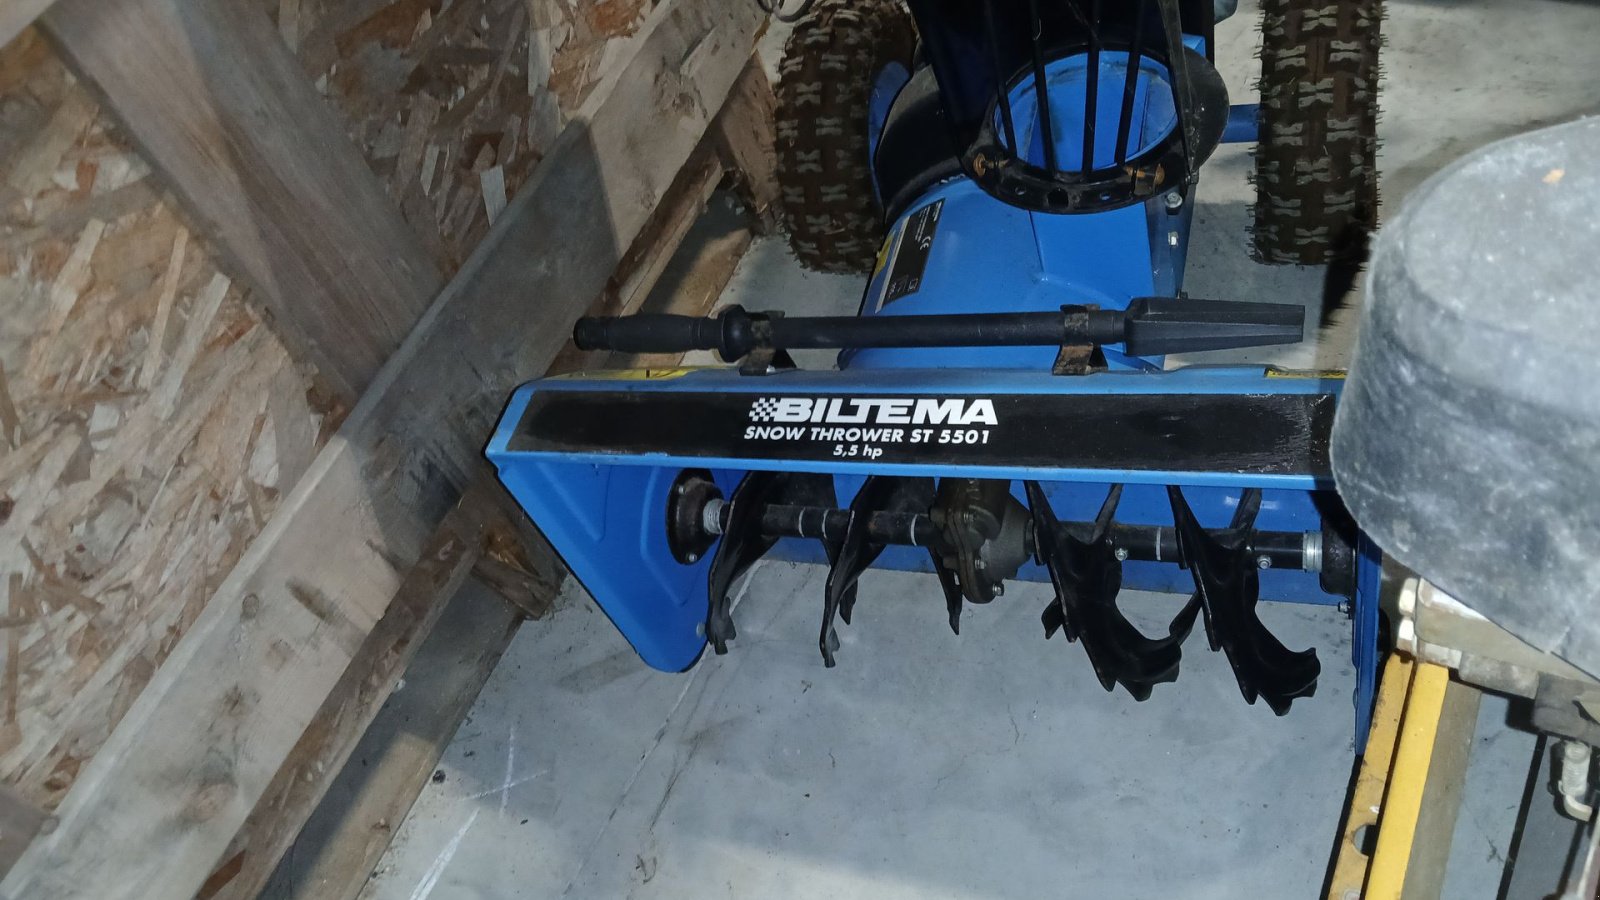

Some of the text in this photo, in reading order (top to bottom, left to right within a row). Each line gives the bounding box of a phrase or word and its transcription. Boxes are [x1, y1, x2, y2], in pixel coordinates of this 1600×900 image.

[773, 397, 998, 425] BILTEMA
[743, 426, 990, 444] SNOW THROWER ST 5501
[832, 444, 883, 460] 5,5 hp
